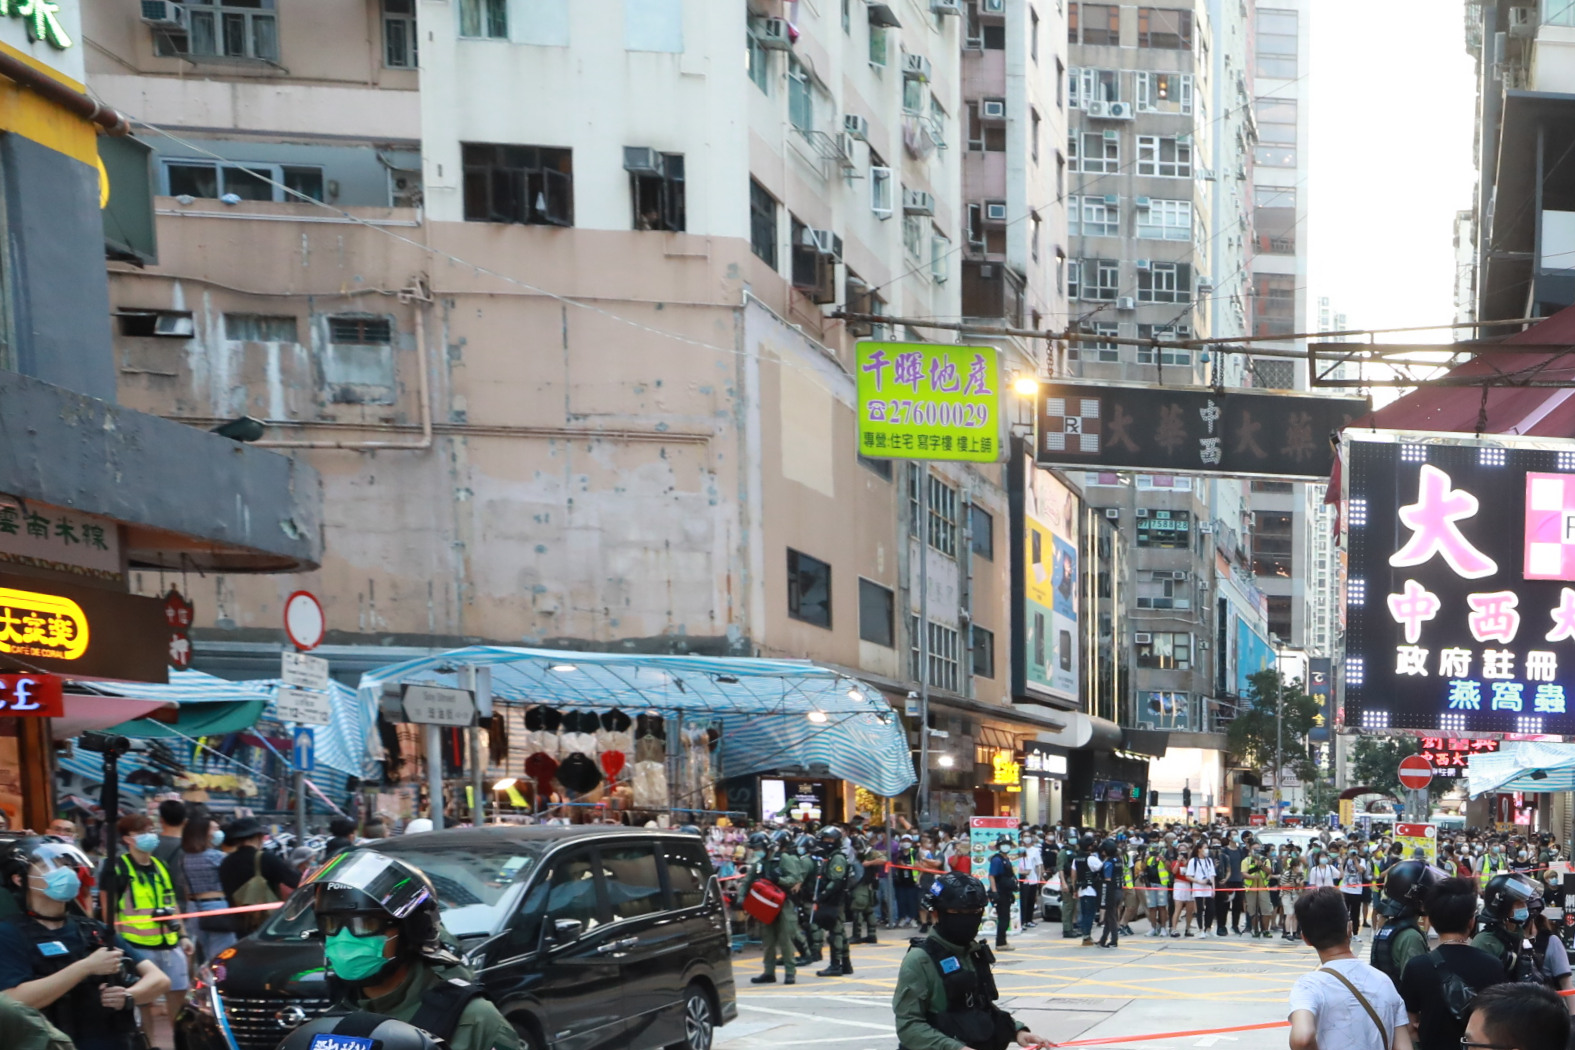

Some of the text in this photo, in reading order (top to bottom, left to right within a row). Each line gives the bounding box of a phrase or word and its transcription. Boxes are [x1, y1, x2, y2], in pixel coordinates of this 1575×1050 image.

[862, 350, 993, 396] 千暉地產
[889, 400, 988, 428] 27600029
[1394, 645, 1559, 682] 政府註冊
